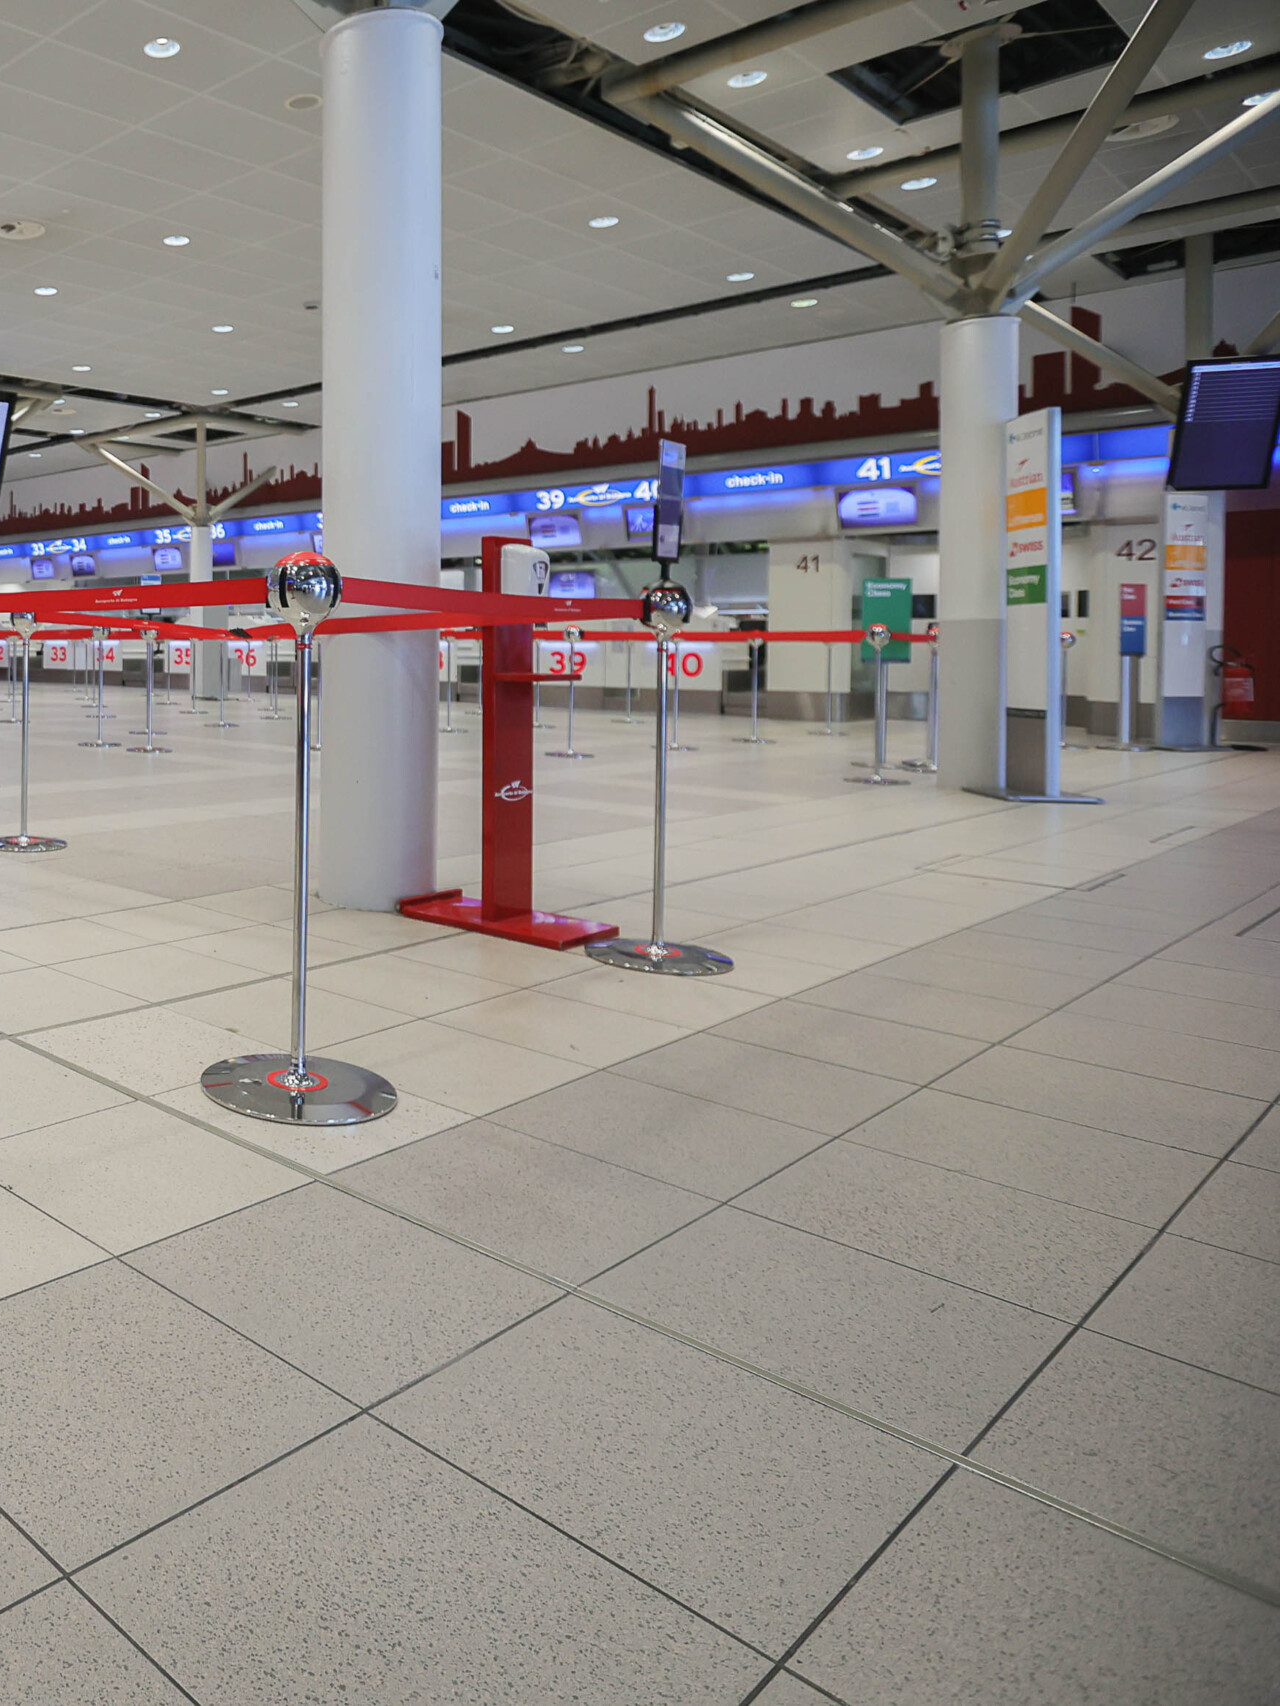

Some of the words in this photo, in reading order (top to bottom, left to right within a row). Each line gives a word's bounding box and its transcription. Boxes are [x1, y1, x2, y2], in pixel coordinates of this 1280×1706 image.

[856, 456, 892, 482] 41
[725, 470, 784, 489] check-in
[449, 499, 490, 514] check-in
[535, 489, 566, 511] 39
[155, 529, 172, 544] 35
[31, 542, 46, 556] 33
[72, 537, 87, 552] 34
[1115, 538, 1157, 561] 42
[796, 554, 820, 574] 41
[50, 647, 67, 662] 33
[234, 648, 257, 667] 36
[549, 651, 587, 675] 39
